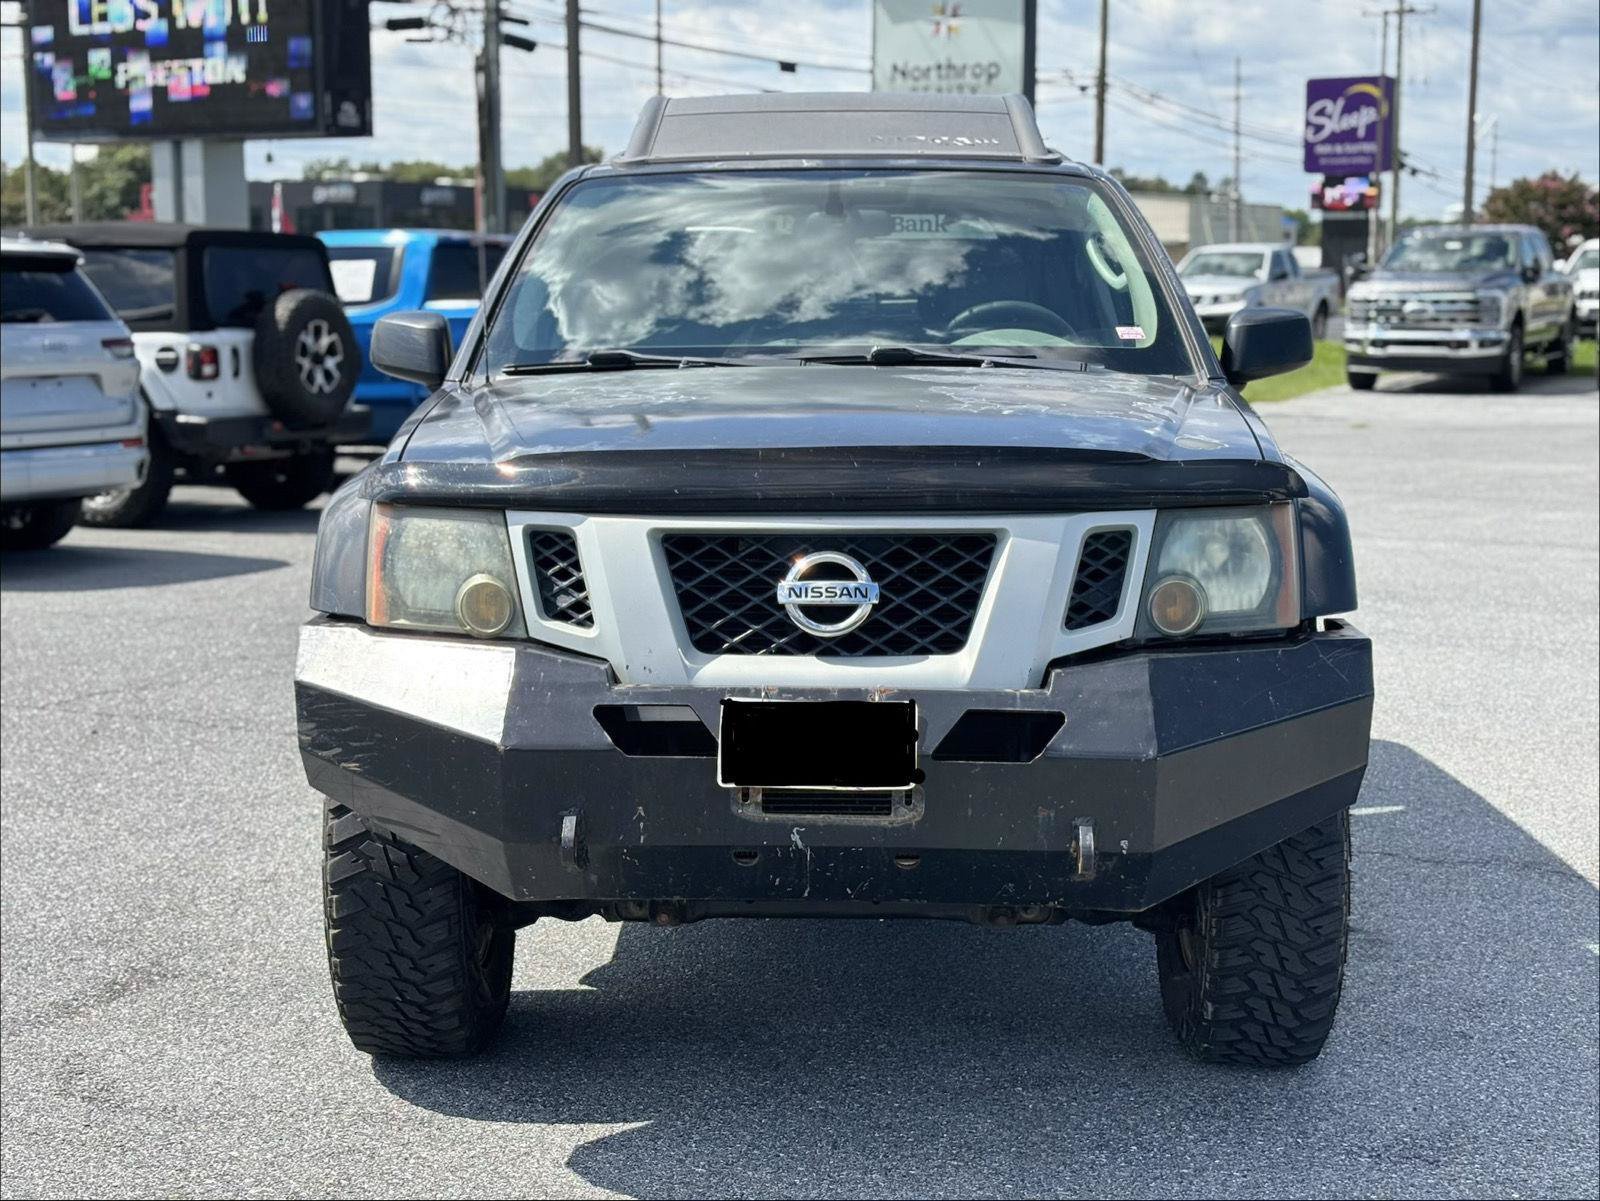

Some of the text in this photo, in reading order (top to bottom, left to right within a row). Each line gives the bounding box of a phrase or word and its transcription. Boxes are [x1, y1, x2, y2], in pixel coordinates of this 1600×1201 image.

[890, 61, 1001, 85] Northrop
[892, 213, 948, 233] Bank
[788, 586, 869, 599] NISSAN
